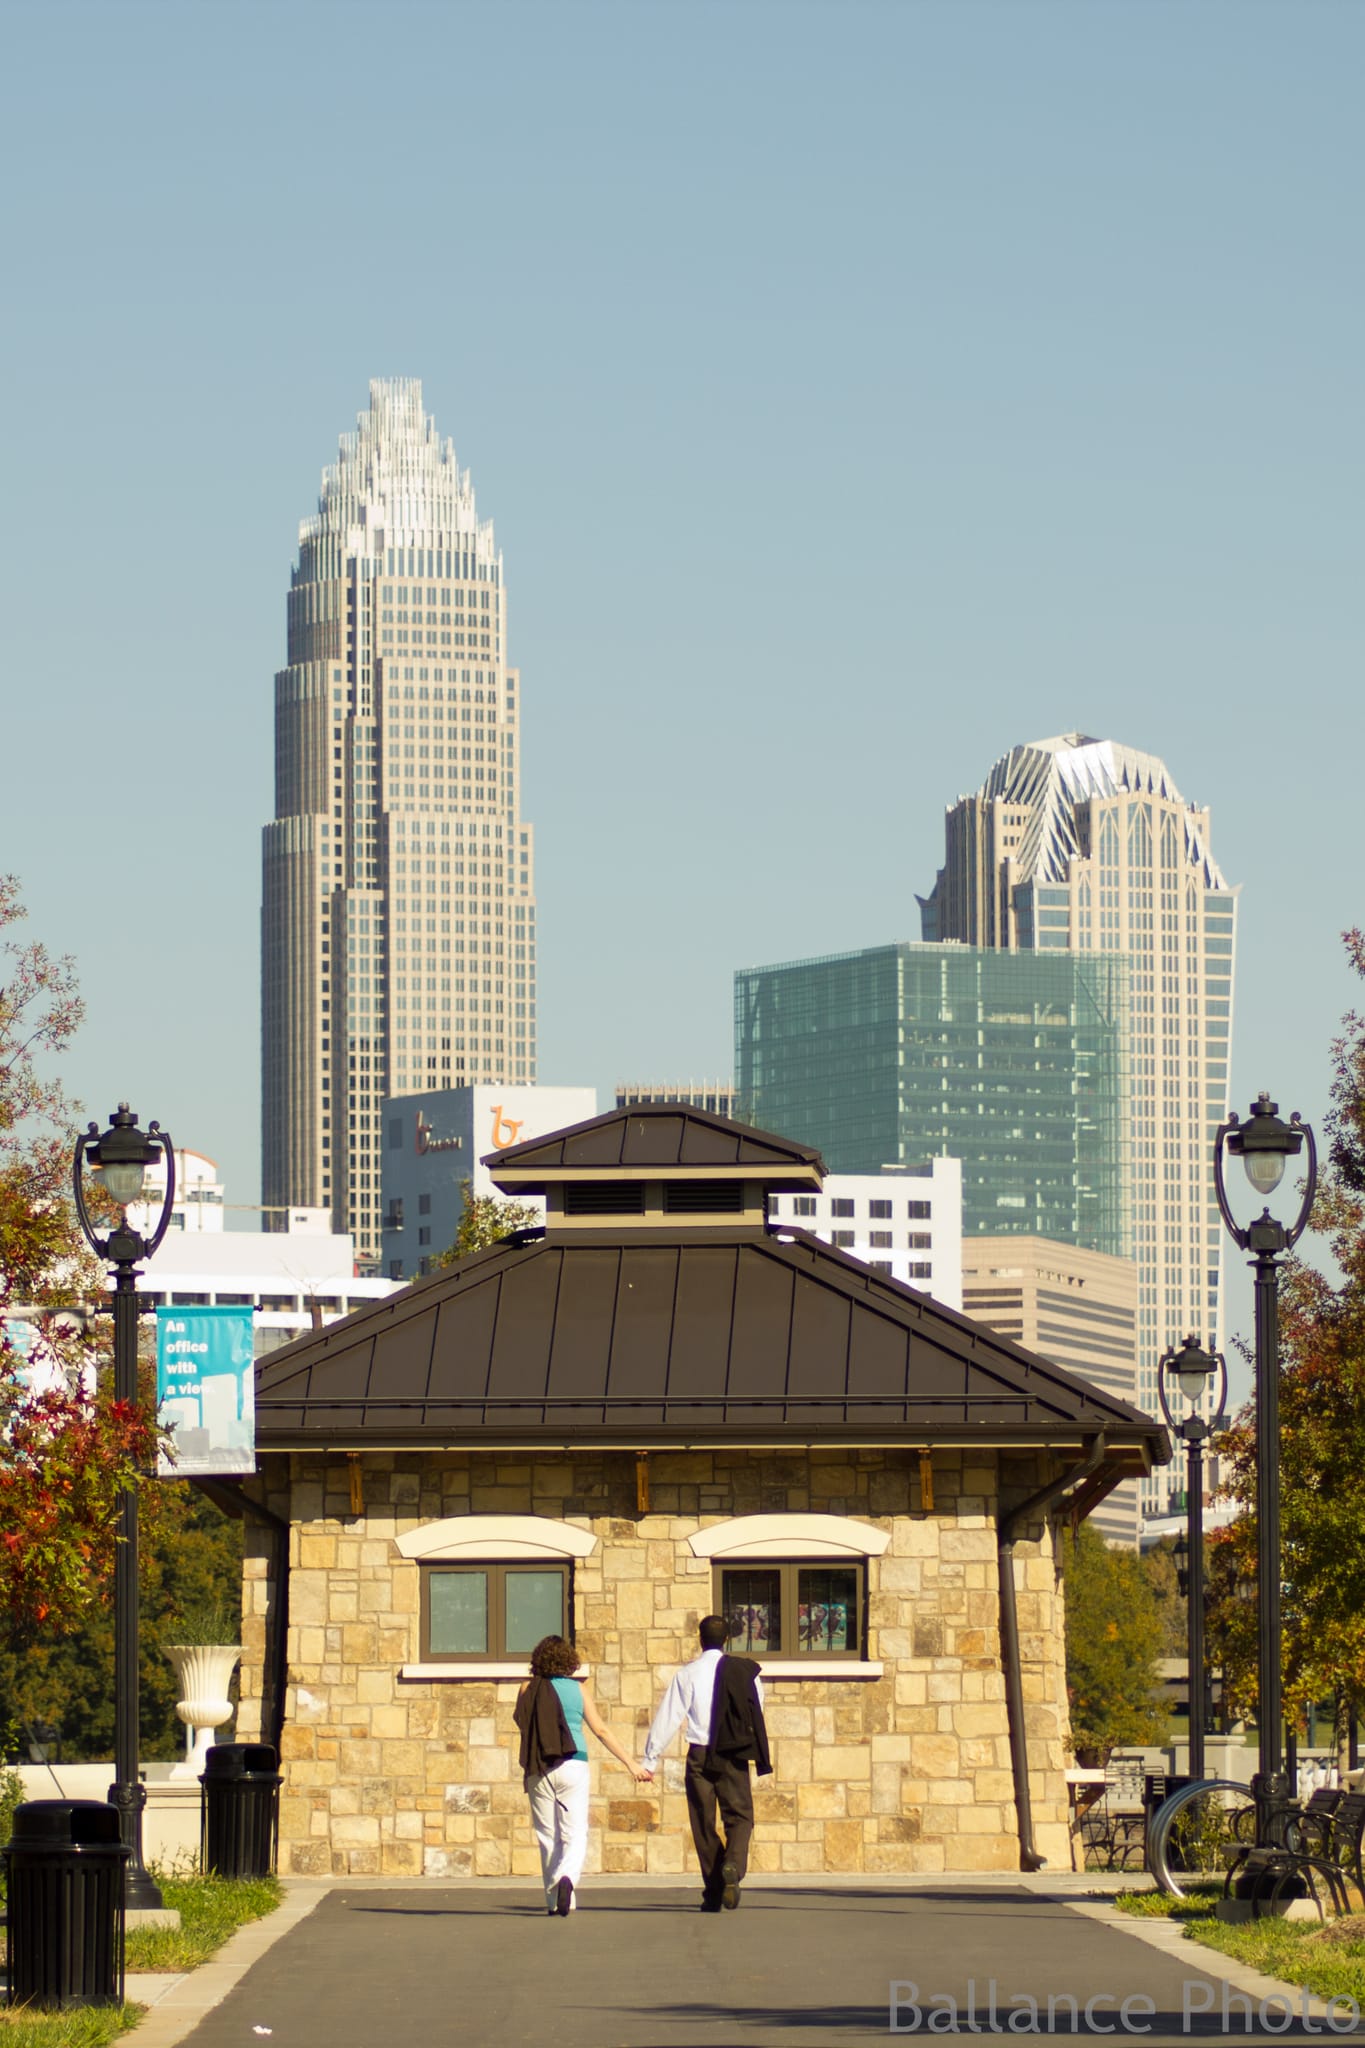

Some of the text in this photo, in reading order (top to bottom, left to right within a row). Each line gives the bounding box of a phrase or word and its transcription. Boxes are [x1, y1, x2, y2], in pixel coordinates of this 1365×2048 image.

[165, 1320, 185, 1333] An
[166, 1340, 209, 1353] office
[166, 1361, 197, 1374] with
[166, 1385, 176, 1395] a
